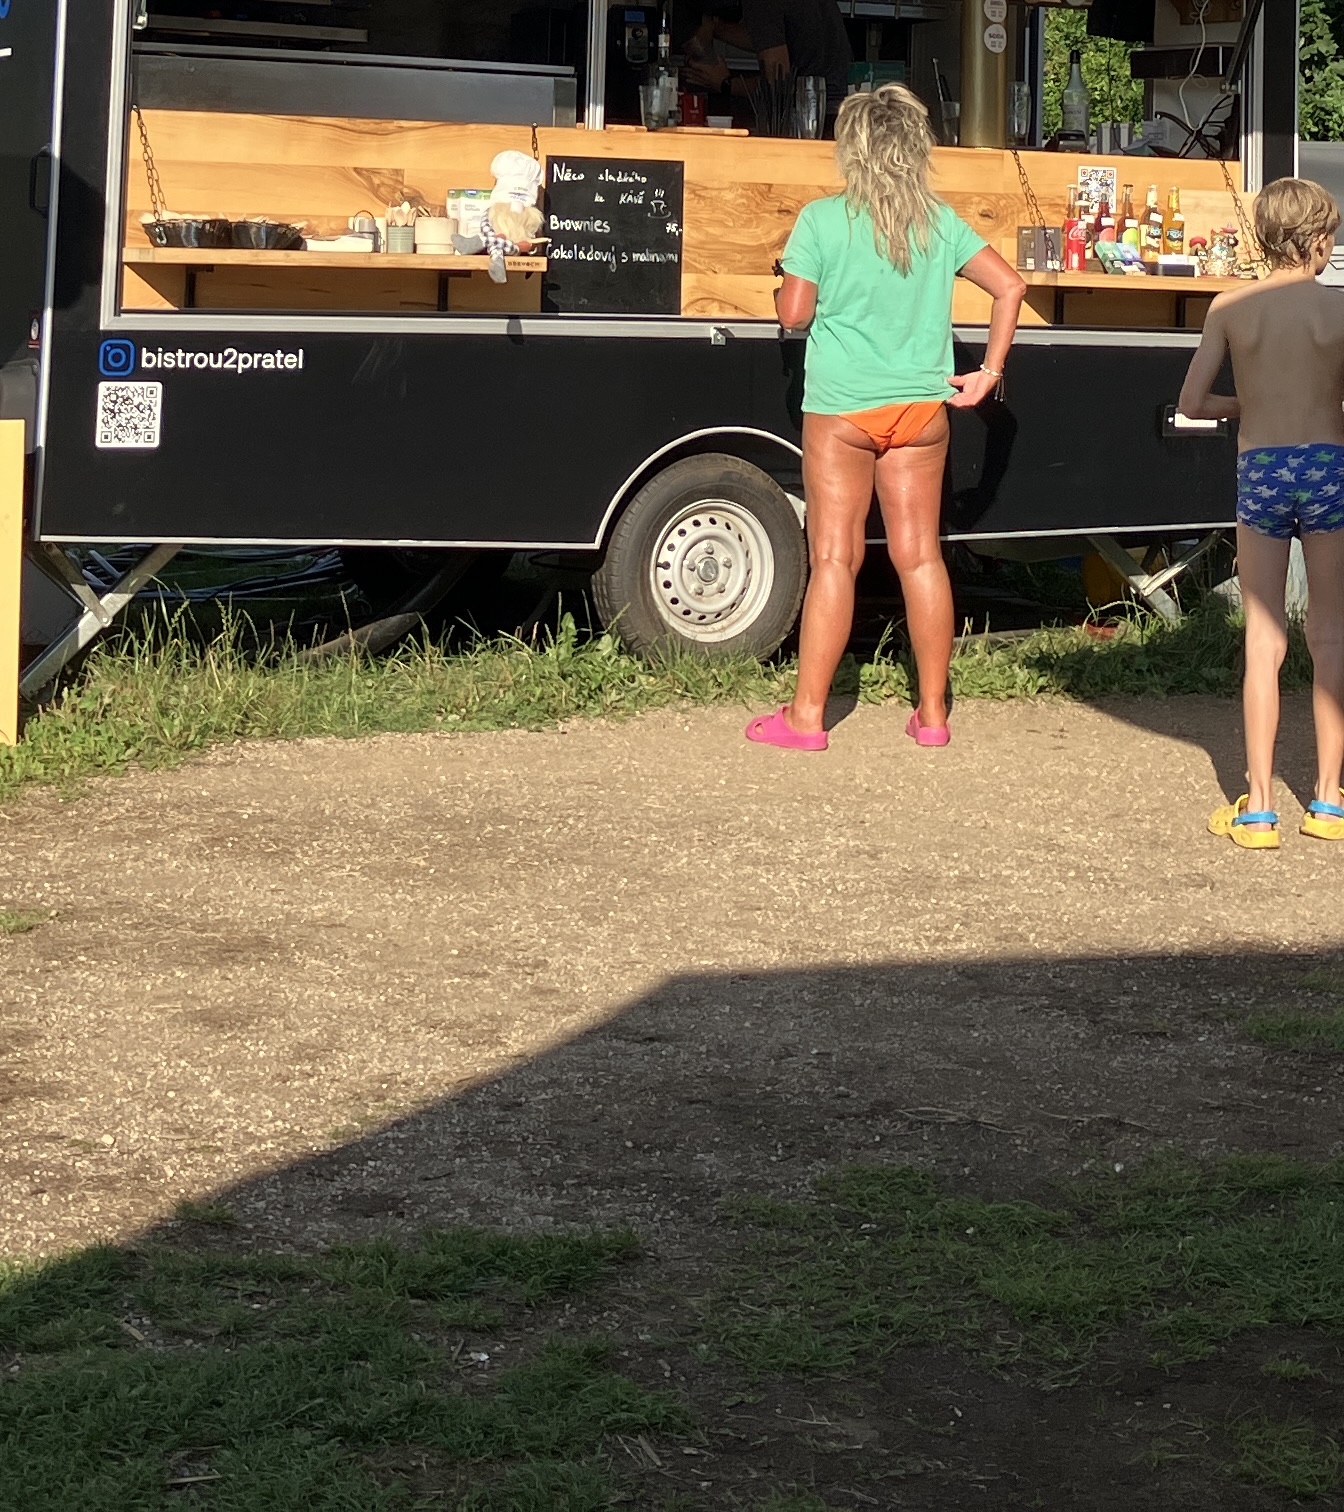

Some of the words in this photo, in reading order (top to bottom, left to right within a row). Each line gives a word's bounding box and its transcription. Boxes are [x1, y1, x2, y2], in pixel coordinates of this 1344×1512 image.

[553, 163, 585, 183] Něco
[549, 214, 611, 234] Brownies
[141, 347, 304, 374] bistrou2pratel
